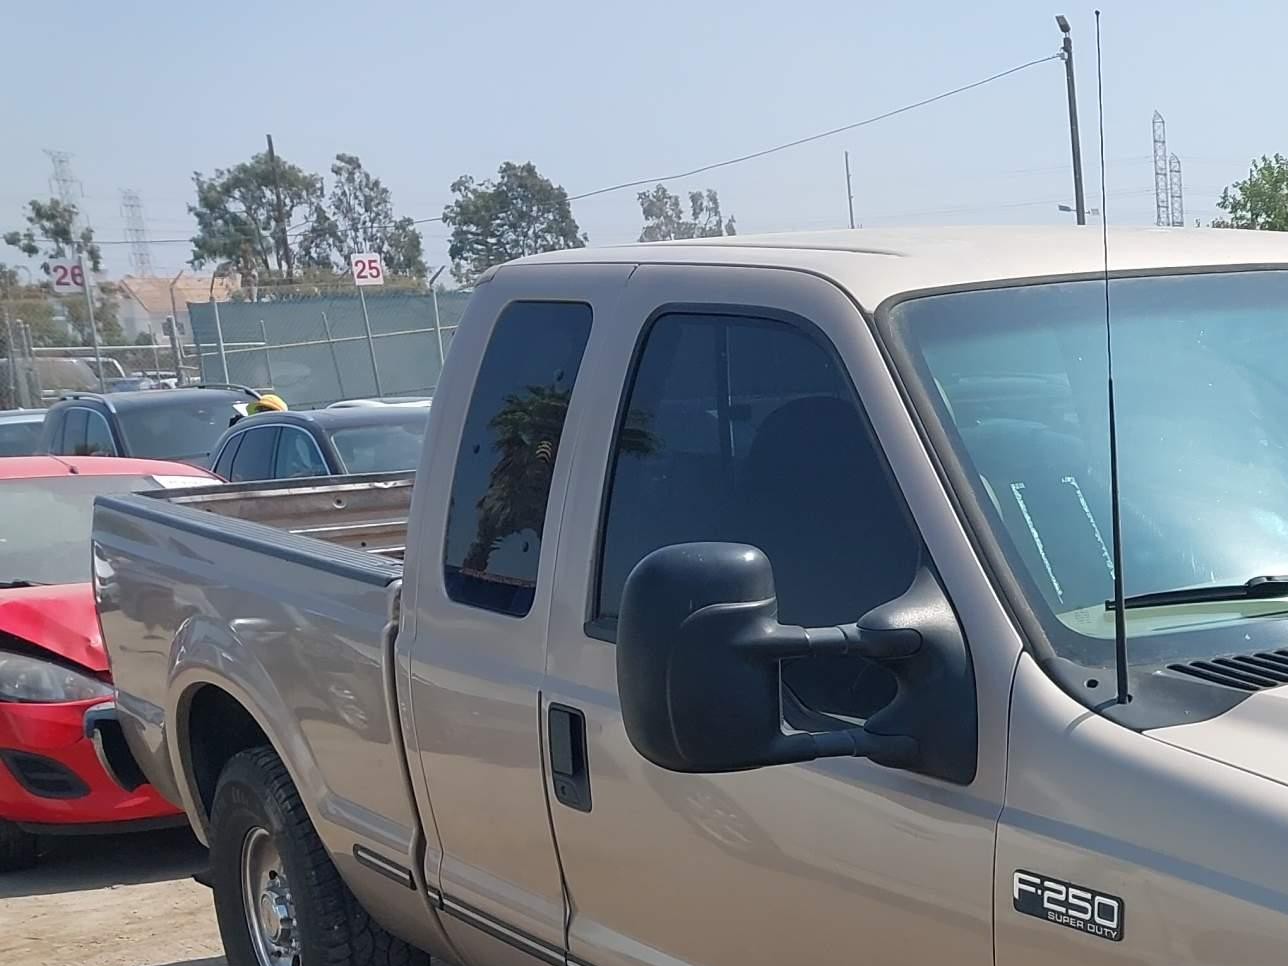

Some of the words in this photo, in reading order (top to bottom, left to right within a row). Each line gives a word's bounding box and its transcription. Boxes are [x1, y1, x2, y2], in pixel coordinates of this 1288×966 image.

[53, 265, 84, 287] 26
[355, 259, 381, 279] 25
[1047, 911, 1084, 929] SUPER
[1087, 923, 1118, 939] DUTY
